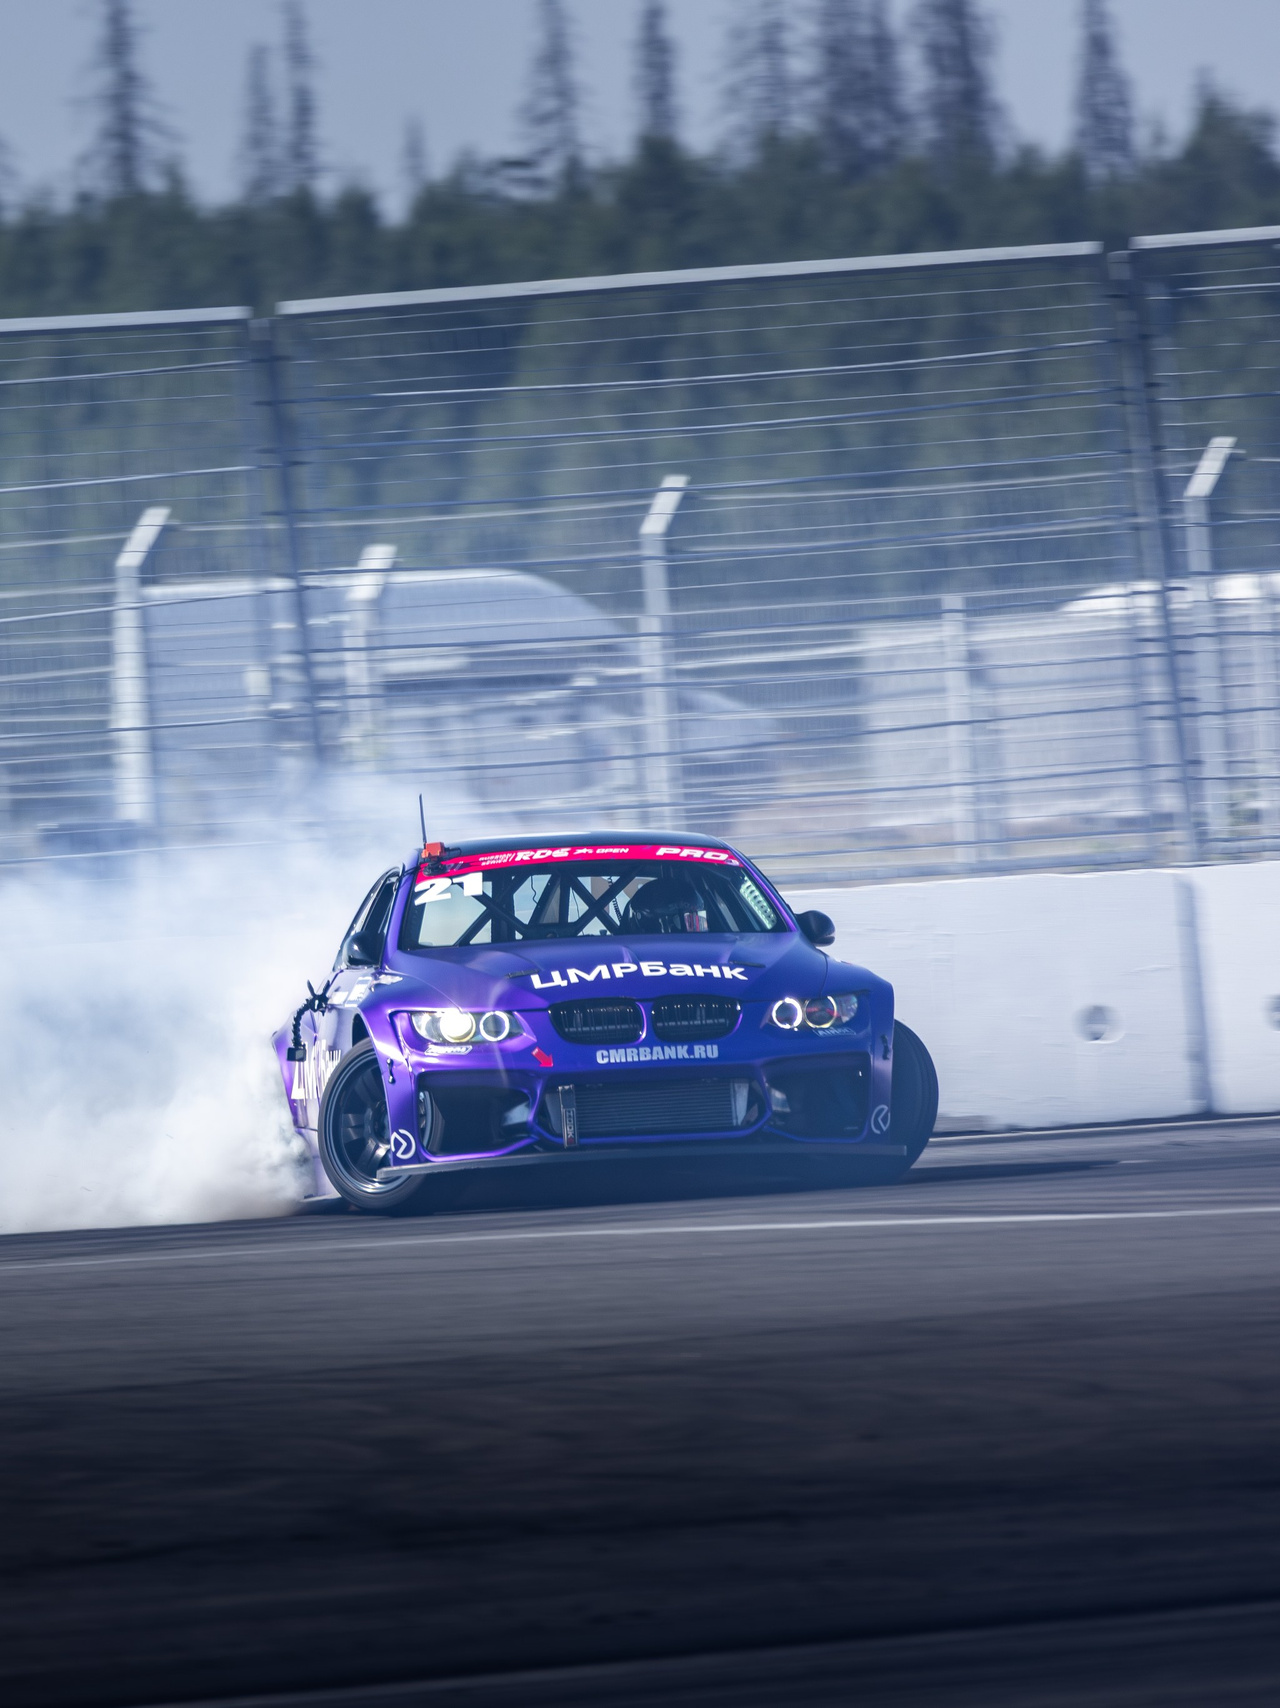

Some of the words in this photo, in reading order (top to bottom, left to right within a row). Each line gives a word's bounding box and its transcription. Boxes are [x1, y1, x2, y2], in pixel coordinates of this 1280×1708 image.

[656, 848, 729, 861] PRO
[414, 872, 483, 906] 21
[530, 961, 749, 989] ЦМРБанк
[596, 1044, 719, 1065] CMRBANK.RU
